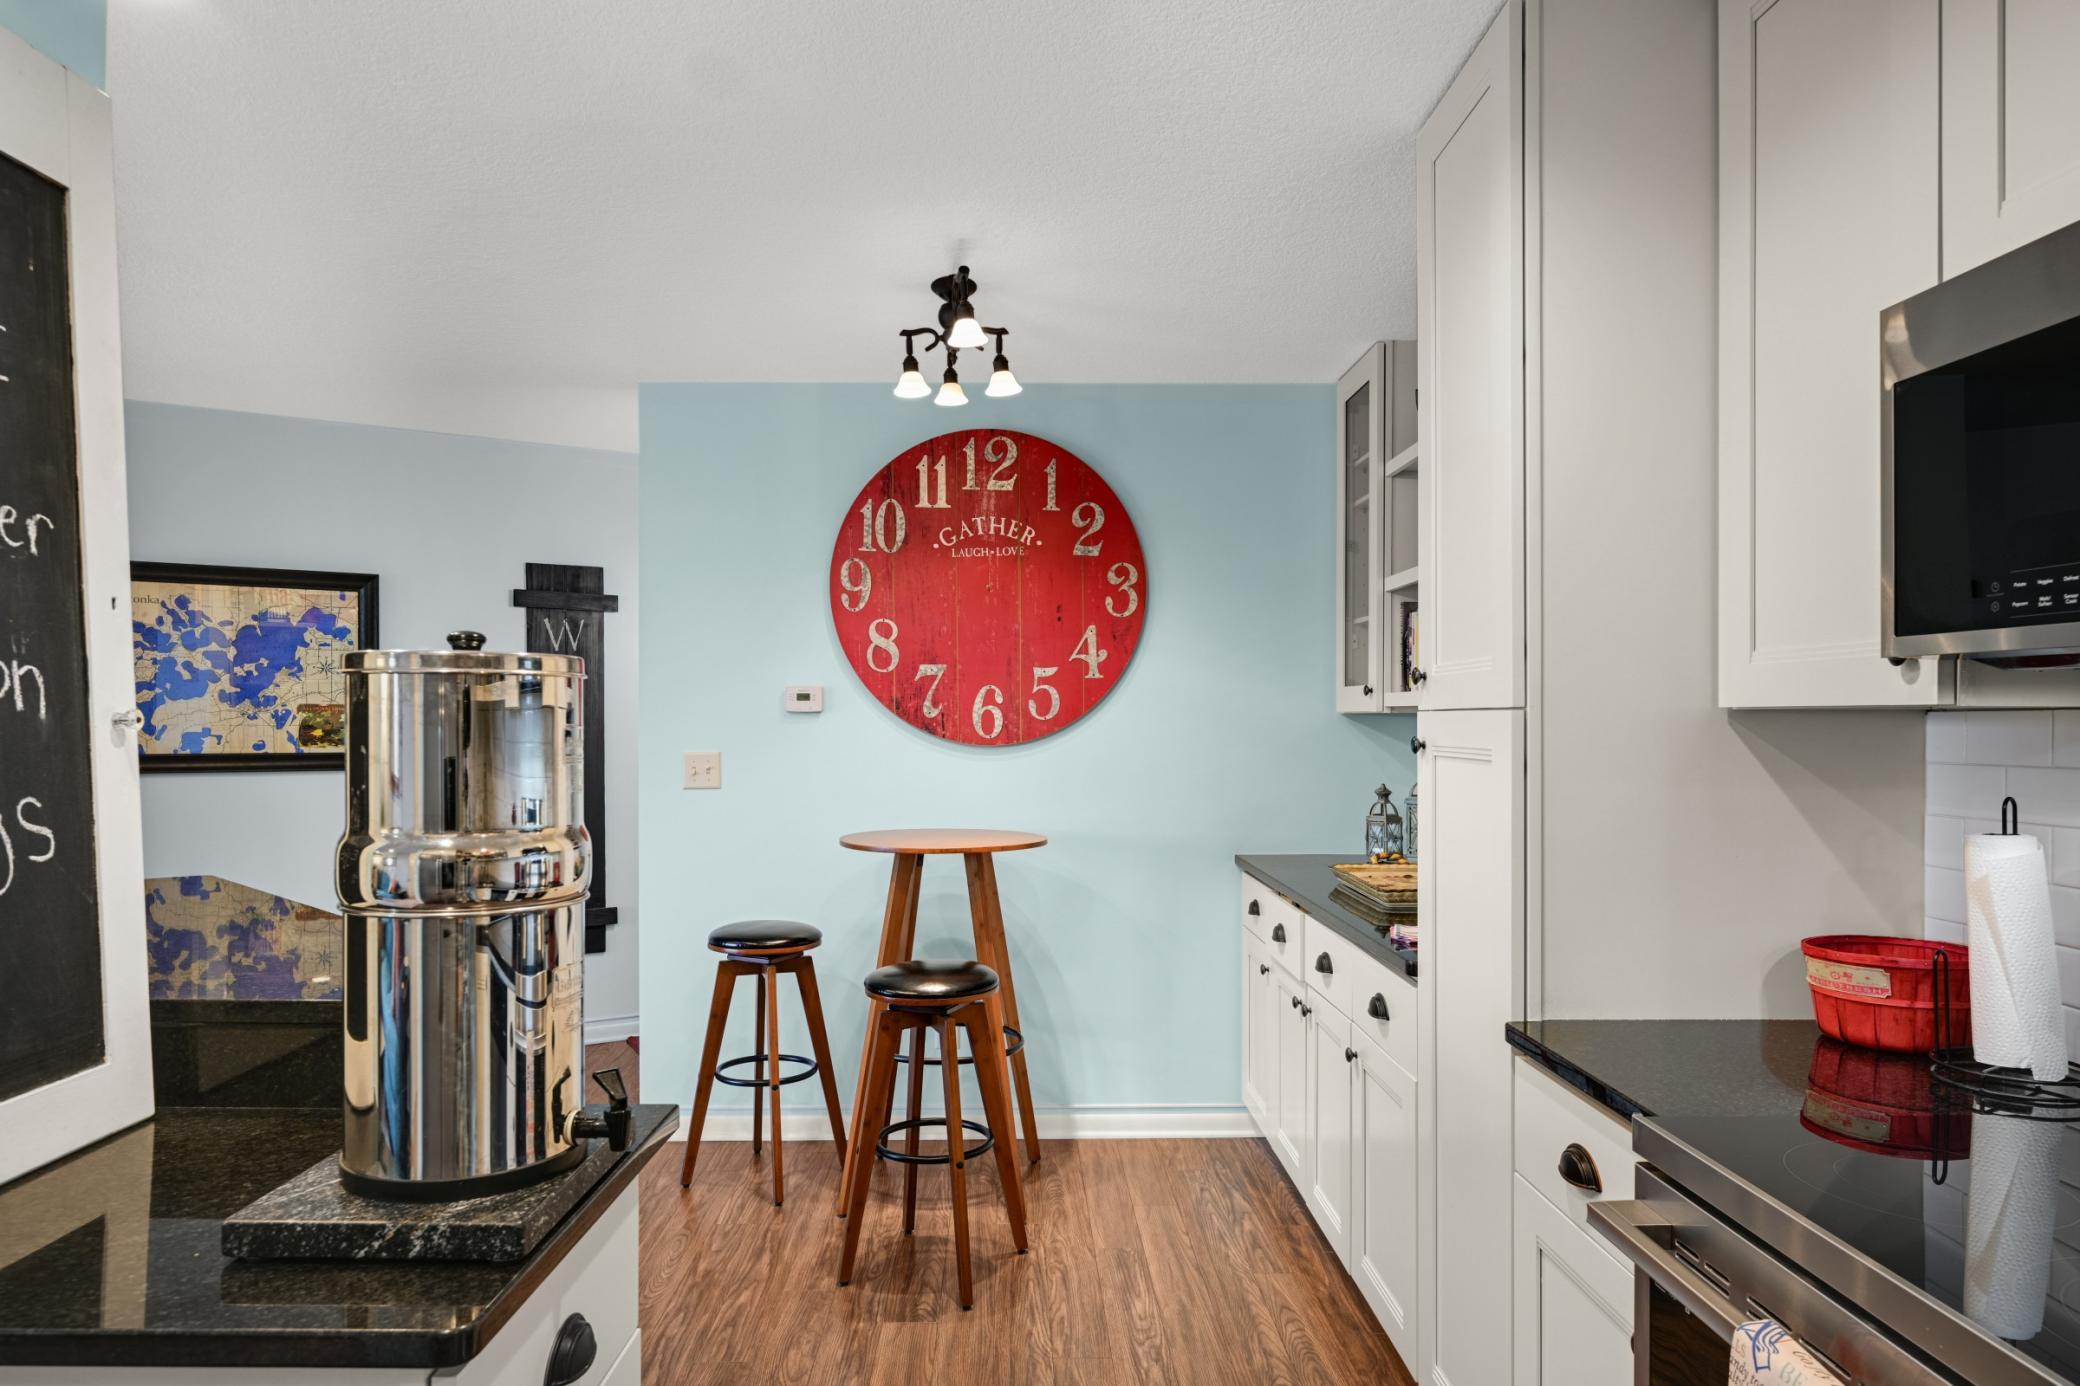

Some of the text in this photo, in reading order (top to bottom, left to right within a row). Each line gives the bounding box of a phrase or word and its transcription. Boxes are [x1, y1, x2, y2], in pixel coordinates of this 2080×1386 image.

[915, 455, 951, 508] 11
[961, 436, 1018, 491] 12
[1042, 458, 1061, 511] 1
[858, 498, 906, 553] 10
[939, 515, 1031, 546] GATHER
[1071, 502, 1105, 556] 2
[840, 557, 872, 613] 9
[1105, 562, 1139, 618] 3
[543, 617, 585, 652] W
[866, 617, 899, 673] 8
[1069, 624, 1108, 679] 4
[914, 663, 948, 719] 7
[972, 684, 1004, 739] 6
[1028, 666, 1061, 721] 5
